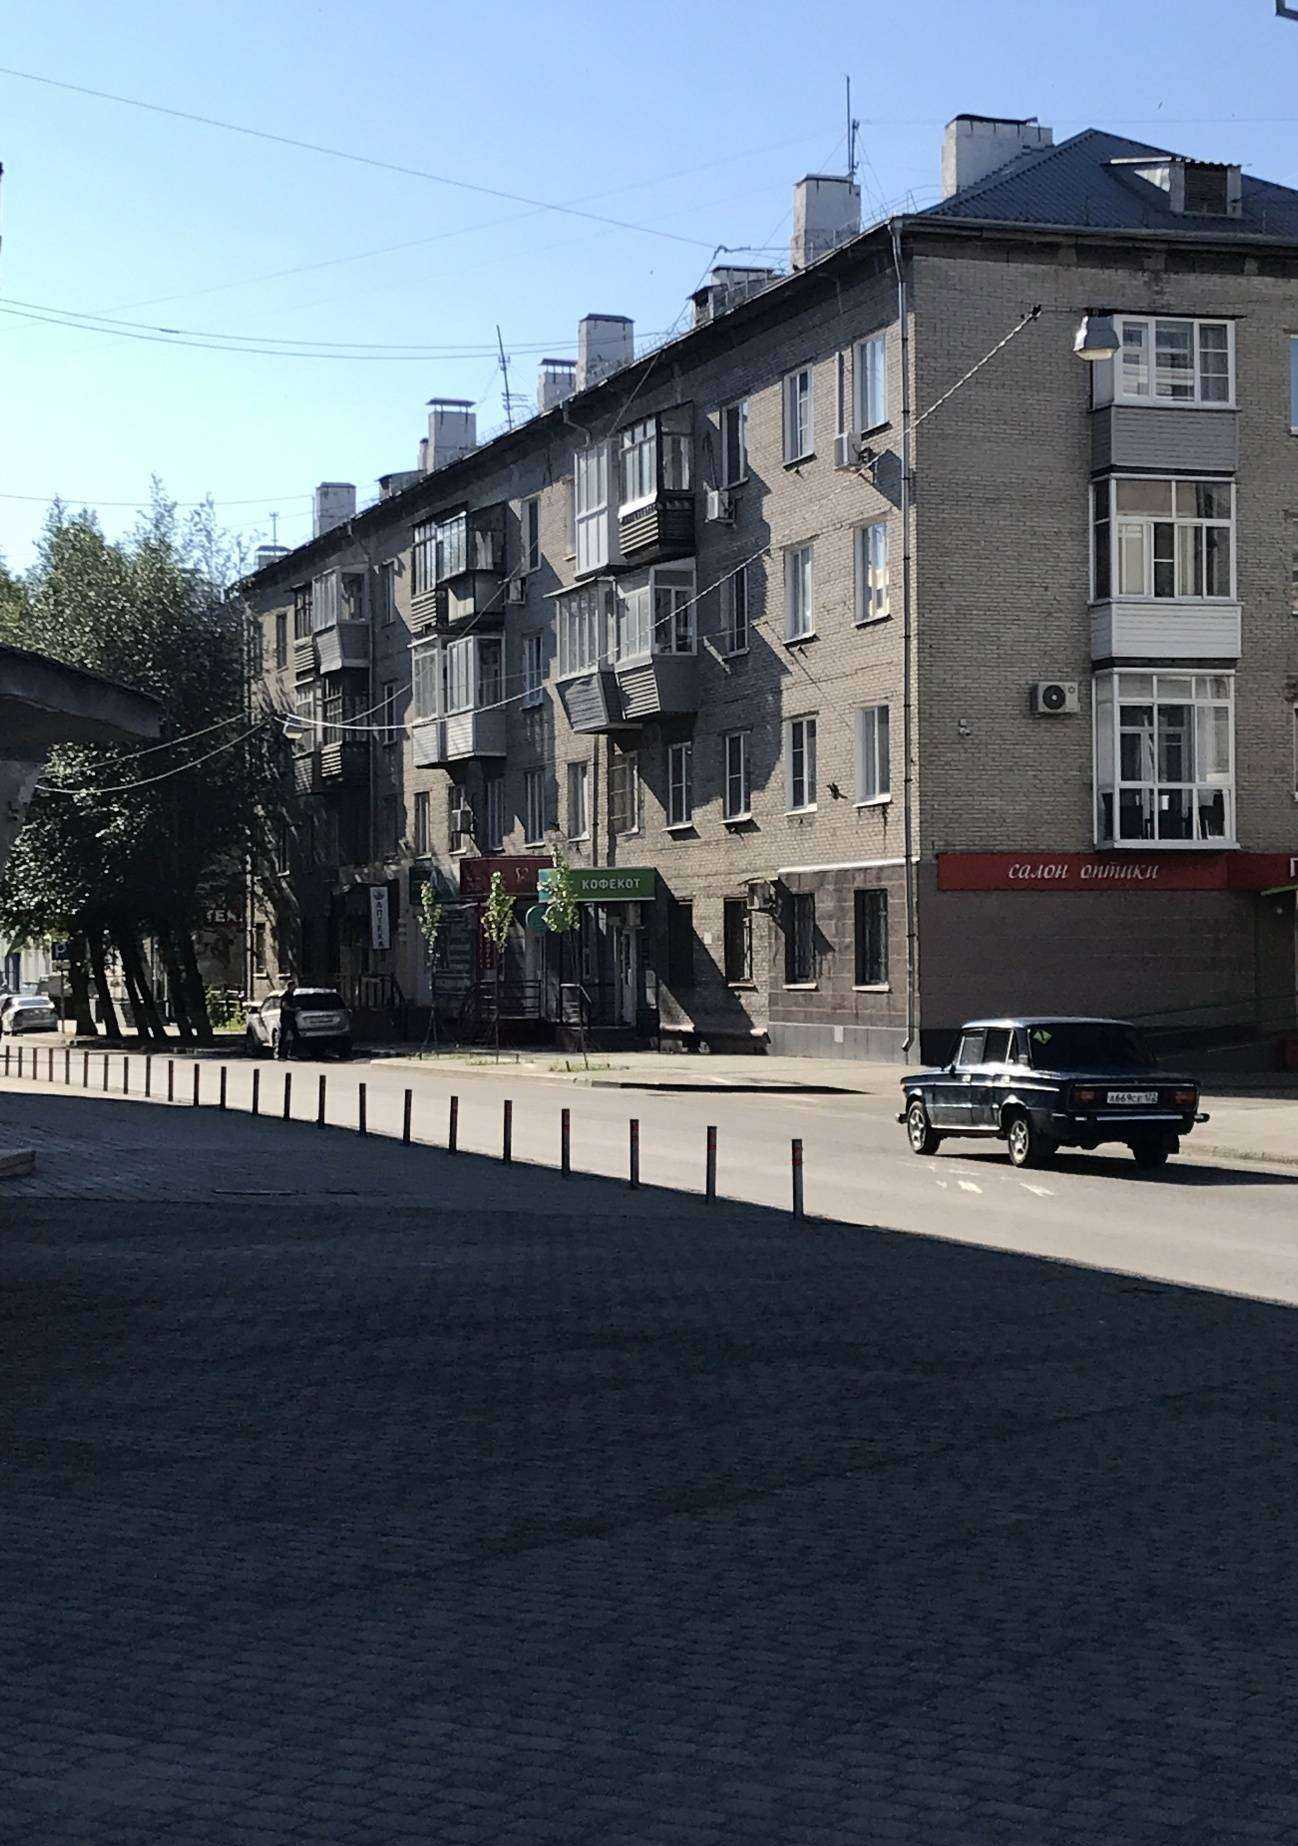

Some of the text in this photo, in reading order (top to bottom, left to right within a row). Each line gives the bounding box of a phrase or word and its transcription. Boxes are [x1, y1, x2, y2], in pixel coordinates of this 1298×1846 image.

[1008, 862, 1160, 880] салон оптики
[582, 878, 640, 890] КОФЕКОТ
